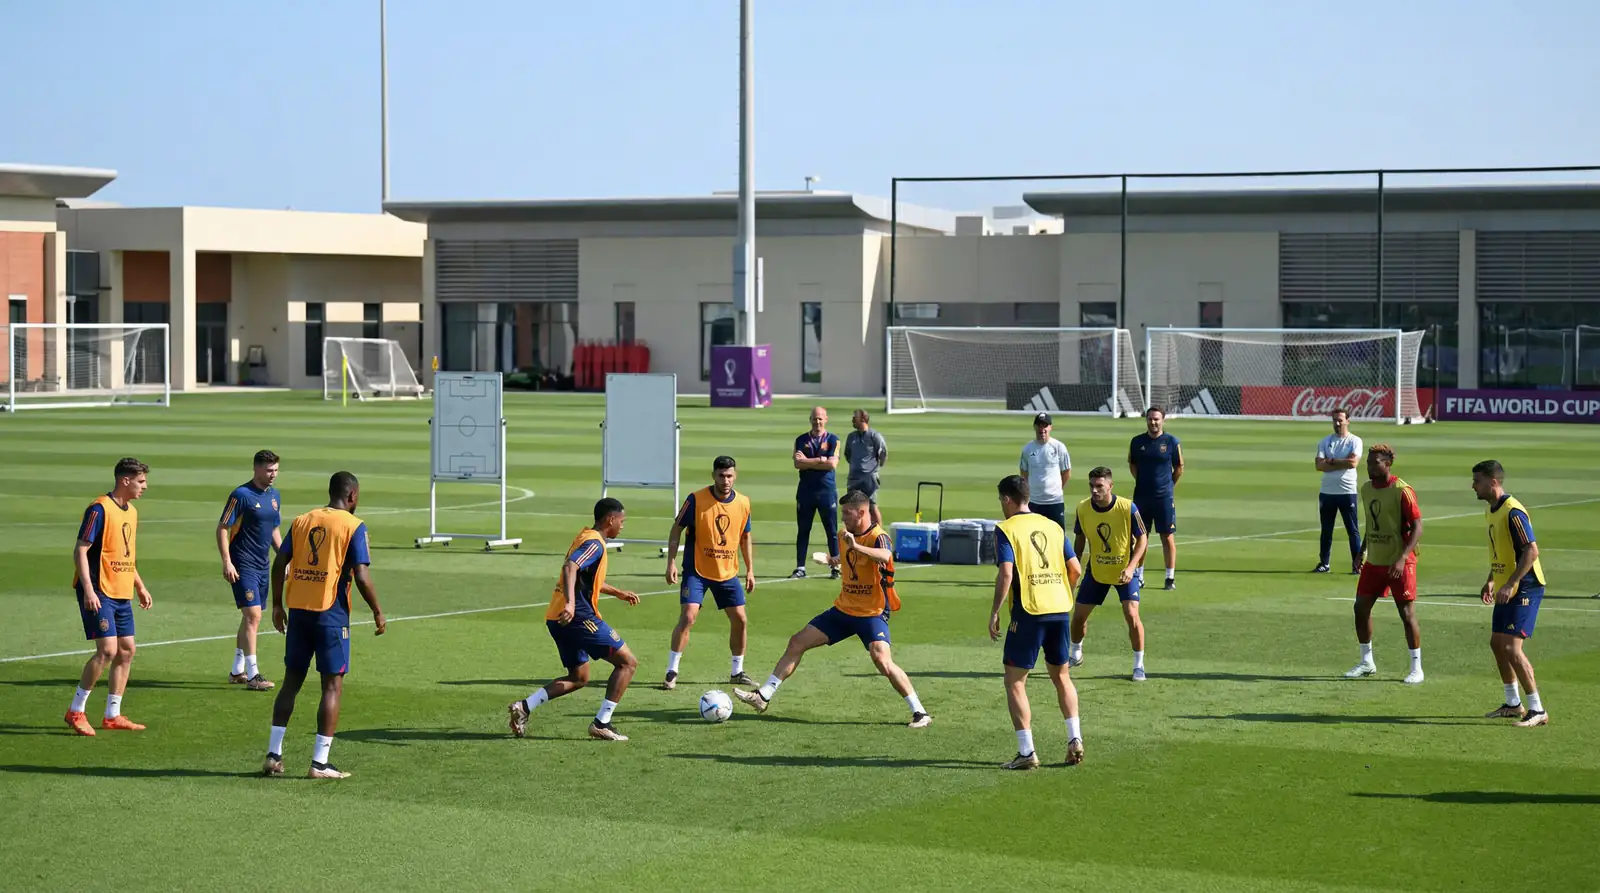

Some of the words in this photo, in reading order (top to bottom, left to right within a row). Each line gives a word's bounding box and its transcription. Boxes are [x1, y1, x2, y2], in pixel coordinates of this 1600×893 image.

[1292, 388, 1388, 418] Coca-Cola
[1446, 397, 1487, 413] FIFA
[1489, 398, 1559, 415] WORLD
[1562, 399, 1600, 416] CUP
